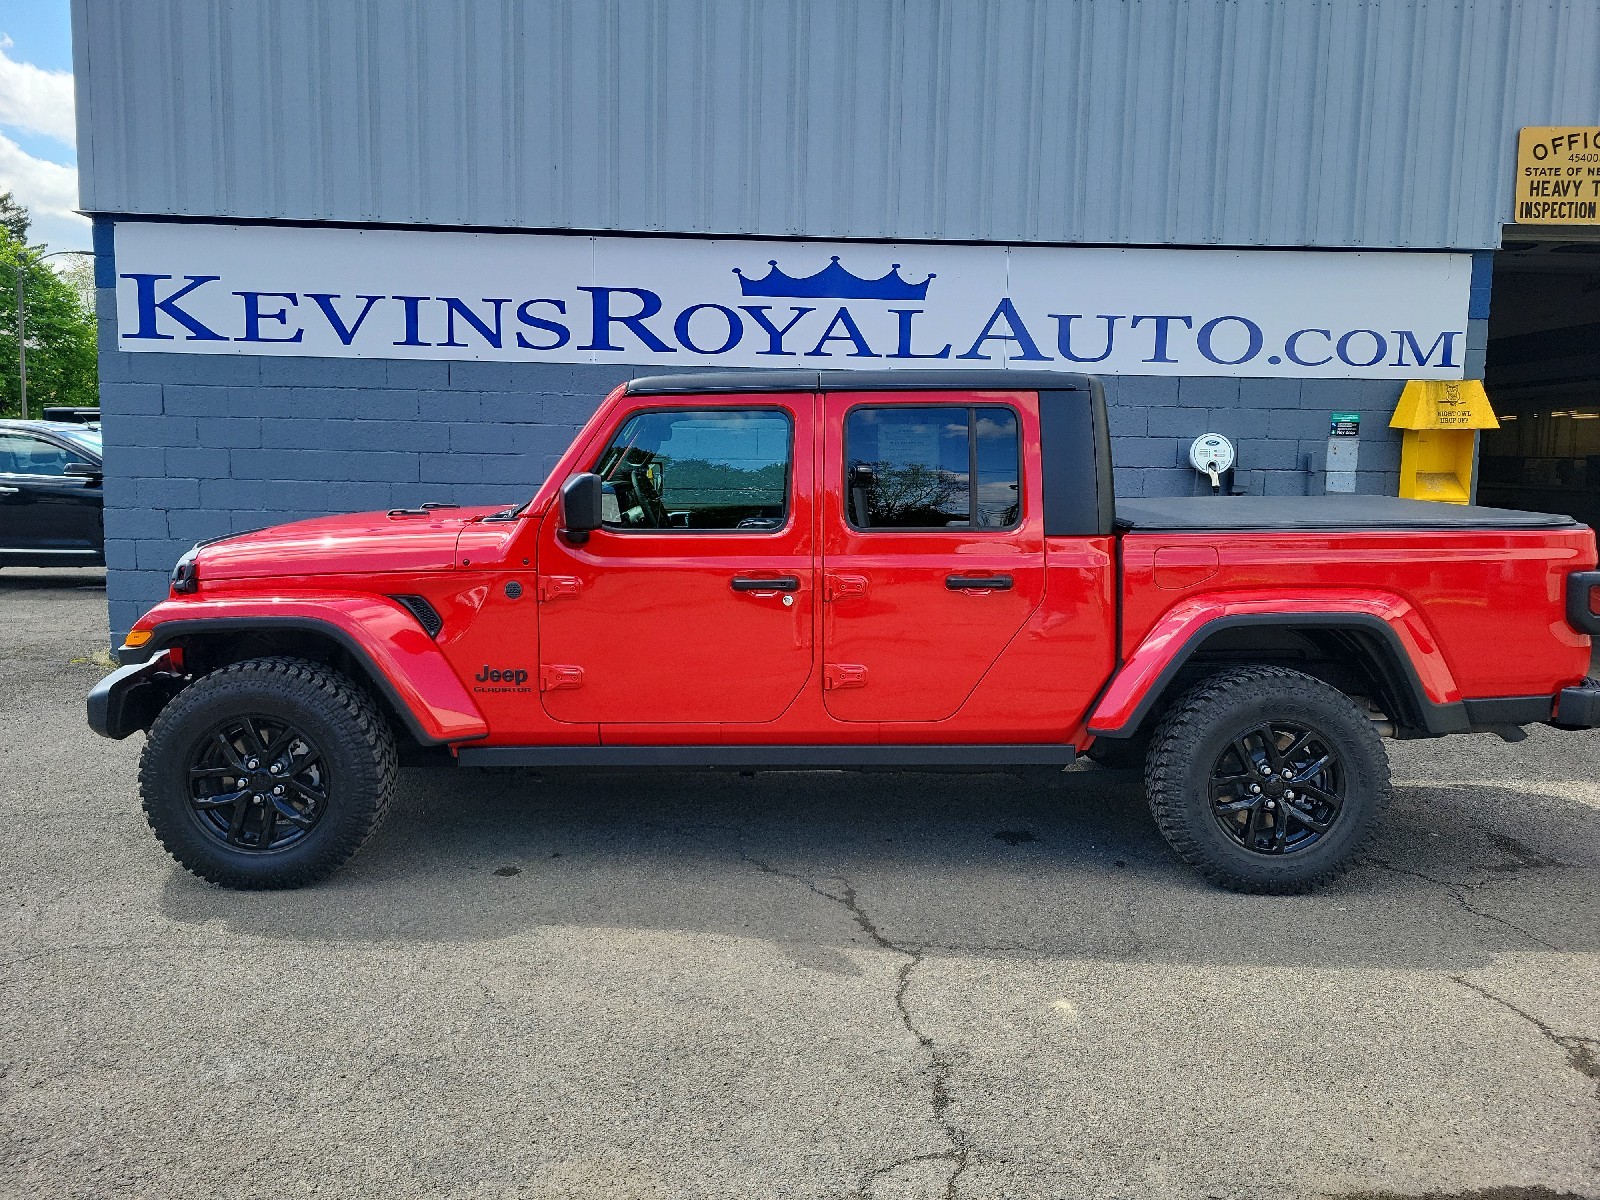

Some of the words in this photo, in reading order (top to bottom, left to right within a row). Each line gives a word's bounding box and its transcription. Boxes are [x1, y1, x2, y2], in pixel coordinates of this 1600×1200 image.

[1568, 153, 1600, 162] 45400
[1525, 167, 1561, 176] STATE
[1566, 167, 1582, 176] OF
[1529, 180, 1583, 197] HEAVY
[1520, 201, 1596, 218] INSPECTION
[475, 664, 528, 685] Jeep
